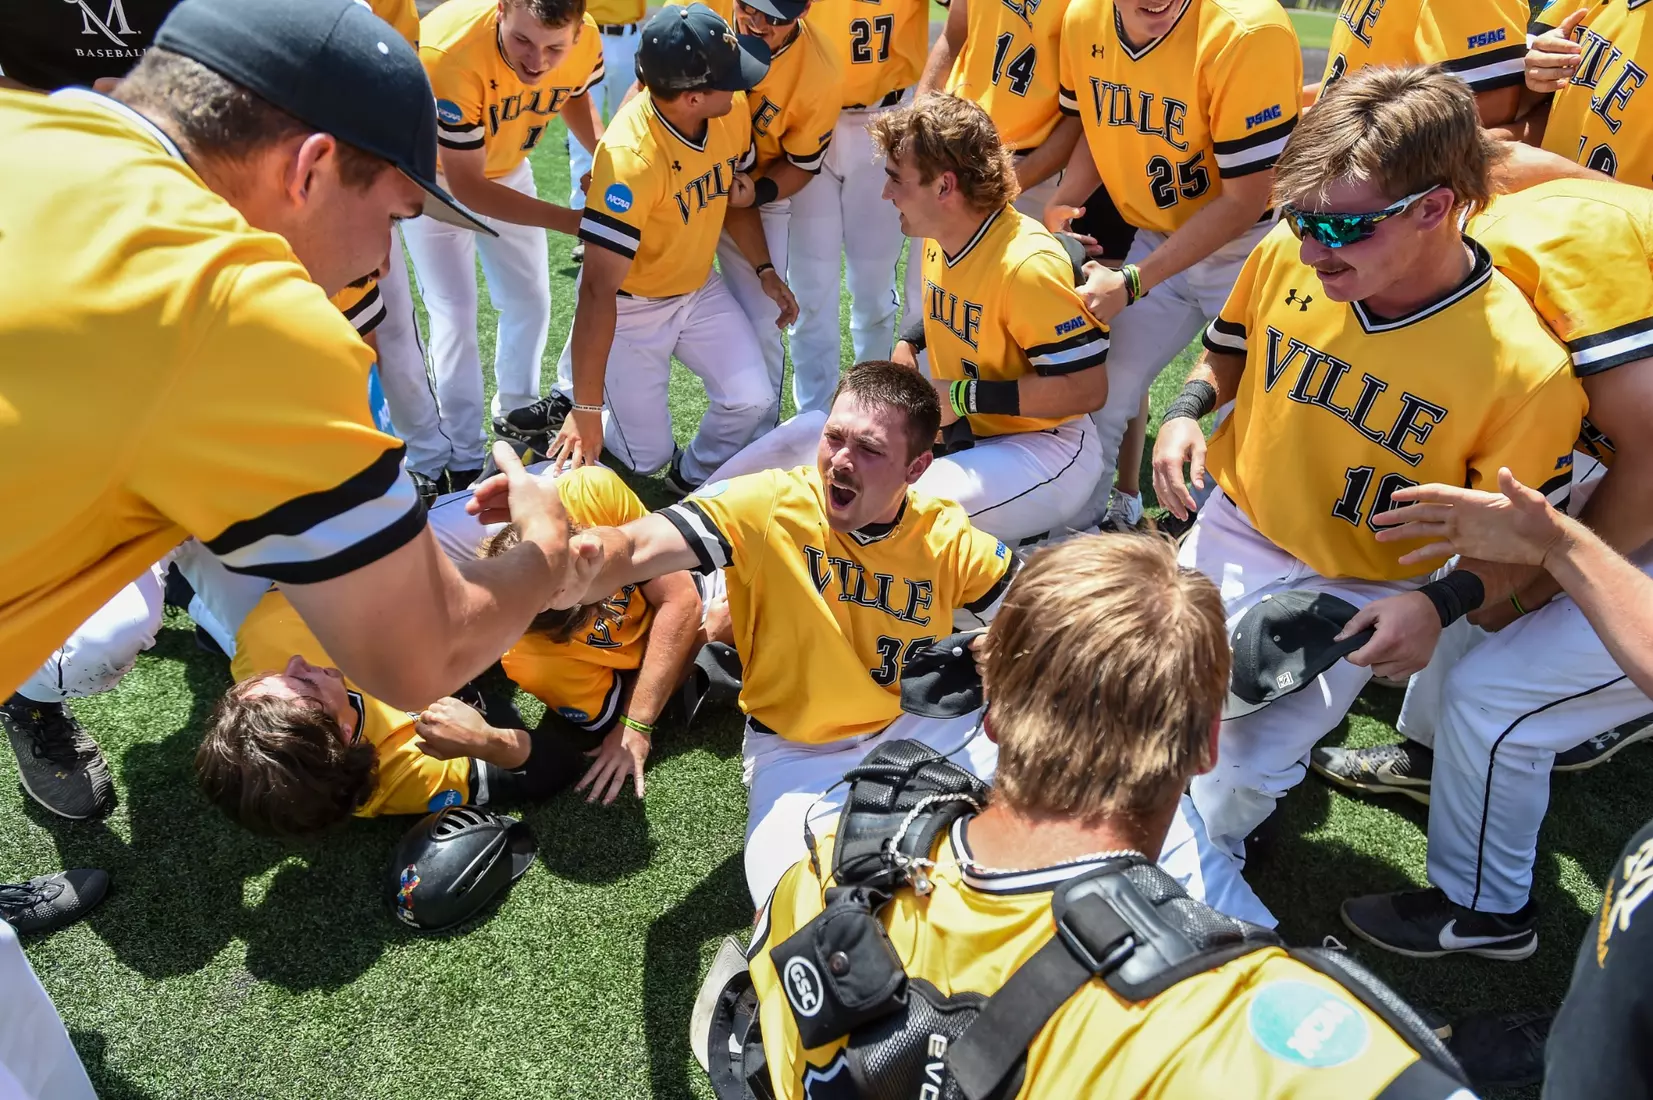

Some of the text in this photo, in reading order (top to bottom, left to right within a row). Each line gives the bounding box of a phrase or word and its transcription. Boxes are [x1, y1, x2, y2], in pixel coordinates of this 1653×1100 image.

[850, 14, 894, 64] 27
[992, 32, 1036, 97] 14
[1467, 28, 1506, 49] PSAC
[520, 120, 549, 151] 1
[1089, 76, 1188, 151] VILLE
[1245, 104, 1282, 130] PSAC
[606, 193, 631, 210] NCAA
[1146, 151, 1210, 209] 25
[924, 277, 983, 353] ILLE
[1055, 315, 1086, 336] PSAC
[1264, 325, 1447, 466] VILLE
[804, 545, 933, 627] VILLE
